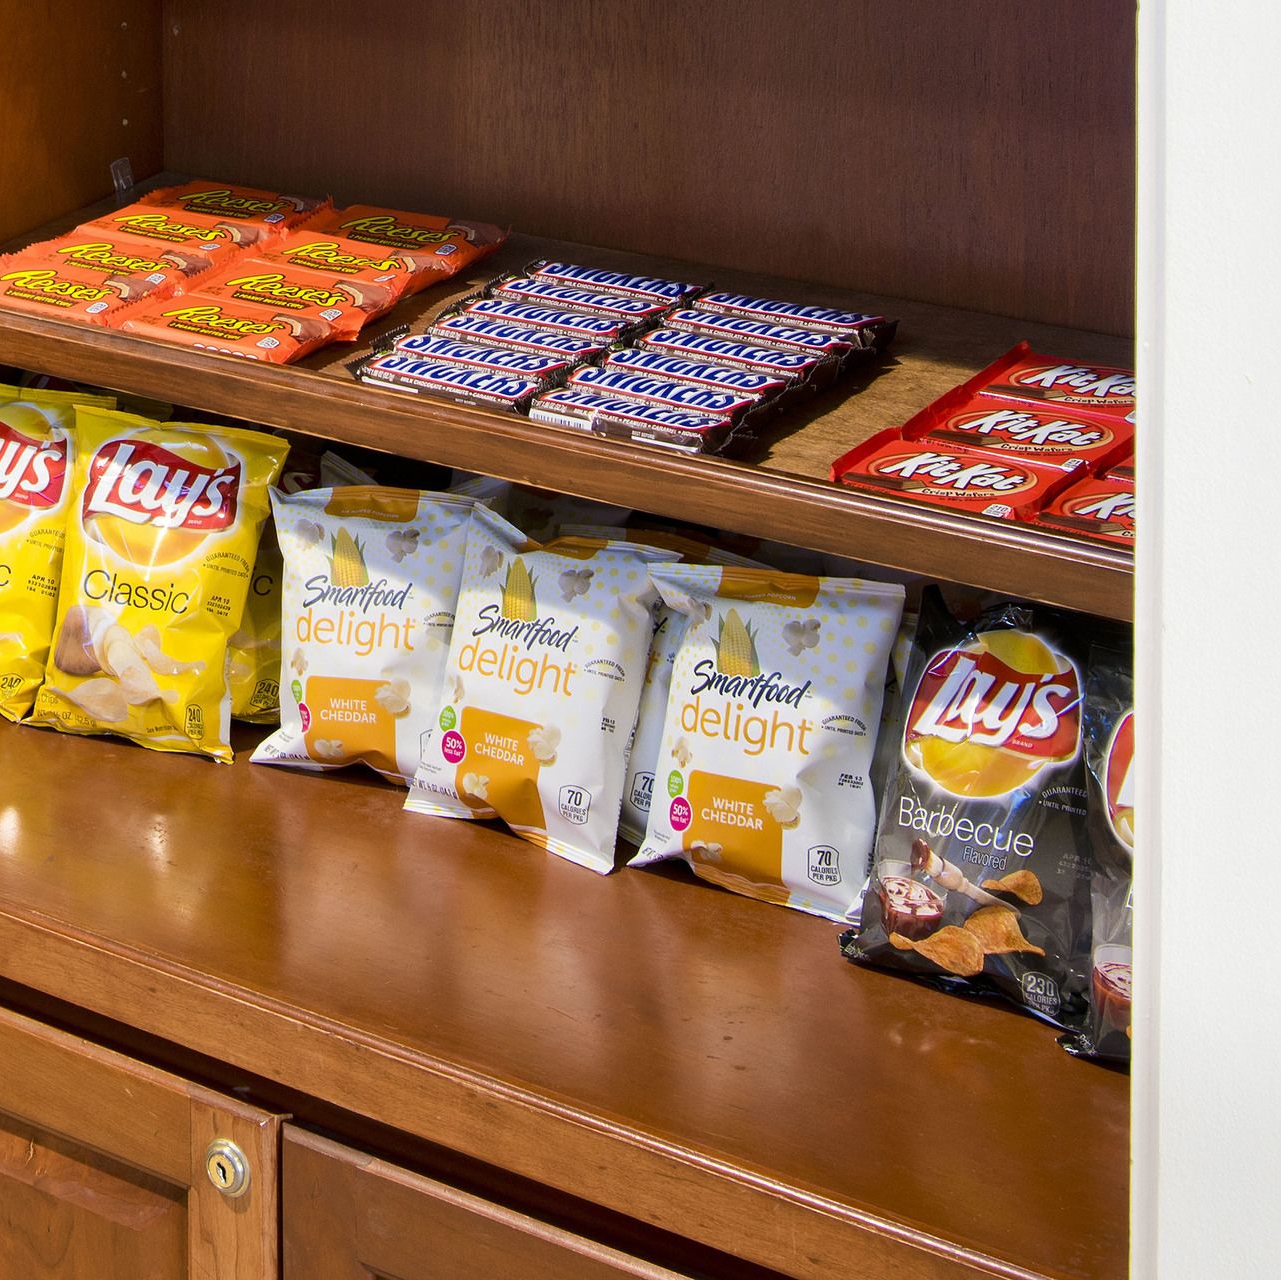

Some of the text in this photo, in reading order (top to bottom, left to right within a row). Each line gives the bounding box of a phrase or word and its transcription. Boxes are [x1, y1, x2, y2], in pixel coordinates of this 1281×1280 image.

[0, 270, 113, 301] Reese's
[226, 274, 347, 307] Reese's
[380, 354, 529, 398] SNICKERS
[81, 441, 235, 526] Lay's
[922, 487, 995, 499] Crisp Wafers
[84, 569, 189, 615] Classic
[302, 576, 413, 615] Smartfood
[296, 606, 415, 657] delight
[472, 605, 578, 652] Smartfood
[458, 637, 575, 697] delight
[691, 659, 812, 709] Smartfood
[320, 709, 377, 724] CHEDDAR
[330, 697, 367, 711] WHITE
[914, 655, 1071, 747] Lay's
[485, 731, 519, 752] WHITE
[681, 700, 812, 756] delight
[474, 743, 524, 766] CHEDDAR
[567, 789, 582, 806] 70
[899, 795, 1035, 857] Barbecue
[817, 850, 832, 866] 70
[963, 845, 1008, 870] Flavored
[812, 873, 838, 882] PER PKG
[1026, 972, 1056, 998] 230
